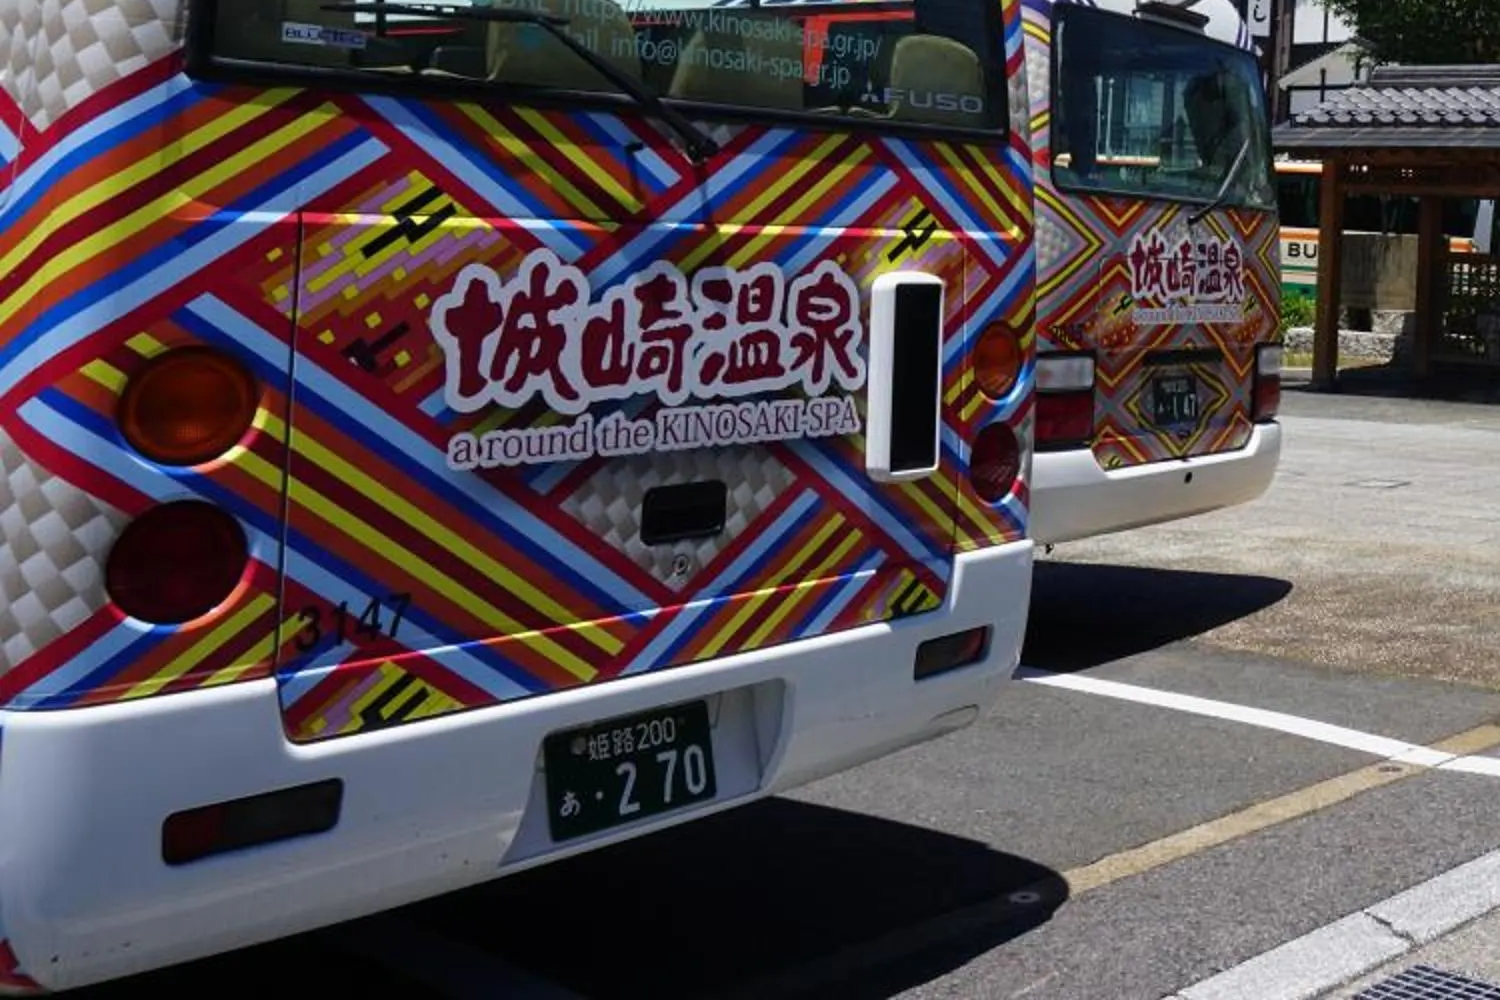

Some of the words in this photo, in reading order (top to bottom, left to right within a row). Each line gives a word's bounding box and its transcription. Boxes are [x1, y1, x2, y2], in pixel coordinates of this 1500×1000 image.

[883, 87, 984, 113] FUSO
[1131, 236, 1243, 297] 城崎温泉
[1287, 241, 1317, 260] BU
[445, 262, 858, 400] 城崎温泉
[601, 423, 651, 452] the
[660, 402, 858, 447] KINOSAKI-SPA
[295, 592, 412, 653] 3147
